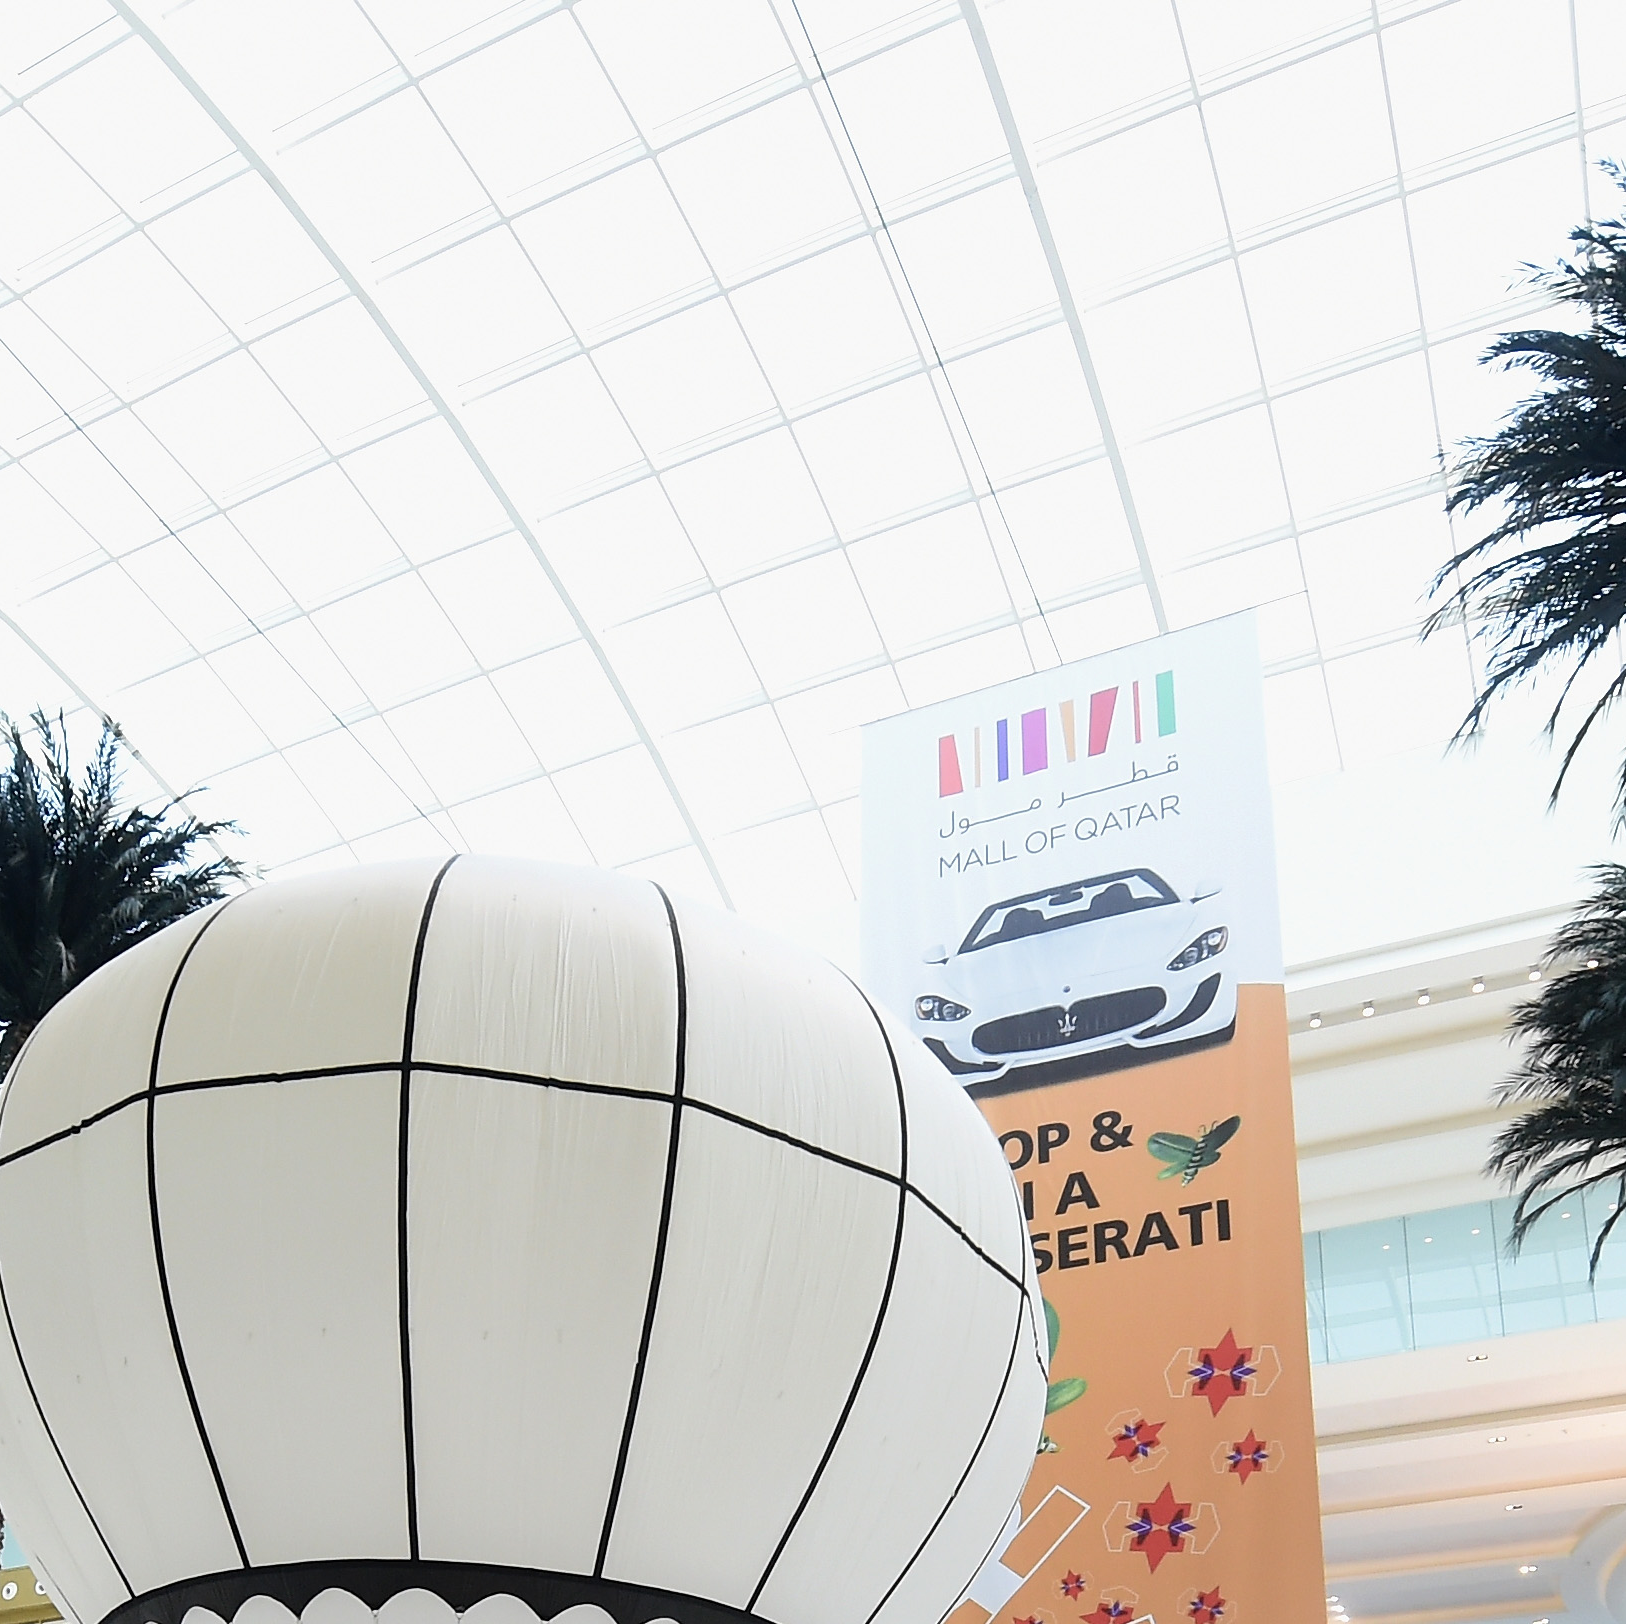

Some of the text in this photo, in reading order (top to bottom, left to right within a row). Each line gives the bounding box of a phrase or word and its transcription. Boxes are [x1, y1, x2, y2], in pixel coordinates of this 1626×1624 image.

[938, 794, 1180, 878] MALL OF QATAR
[998, 1110, 1134, 1171] OP &
[1055, 1171, 1100, 1216] A
[1031, 1199, 1231, 1275] SERATI
